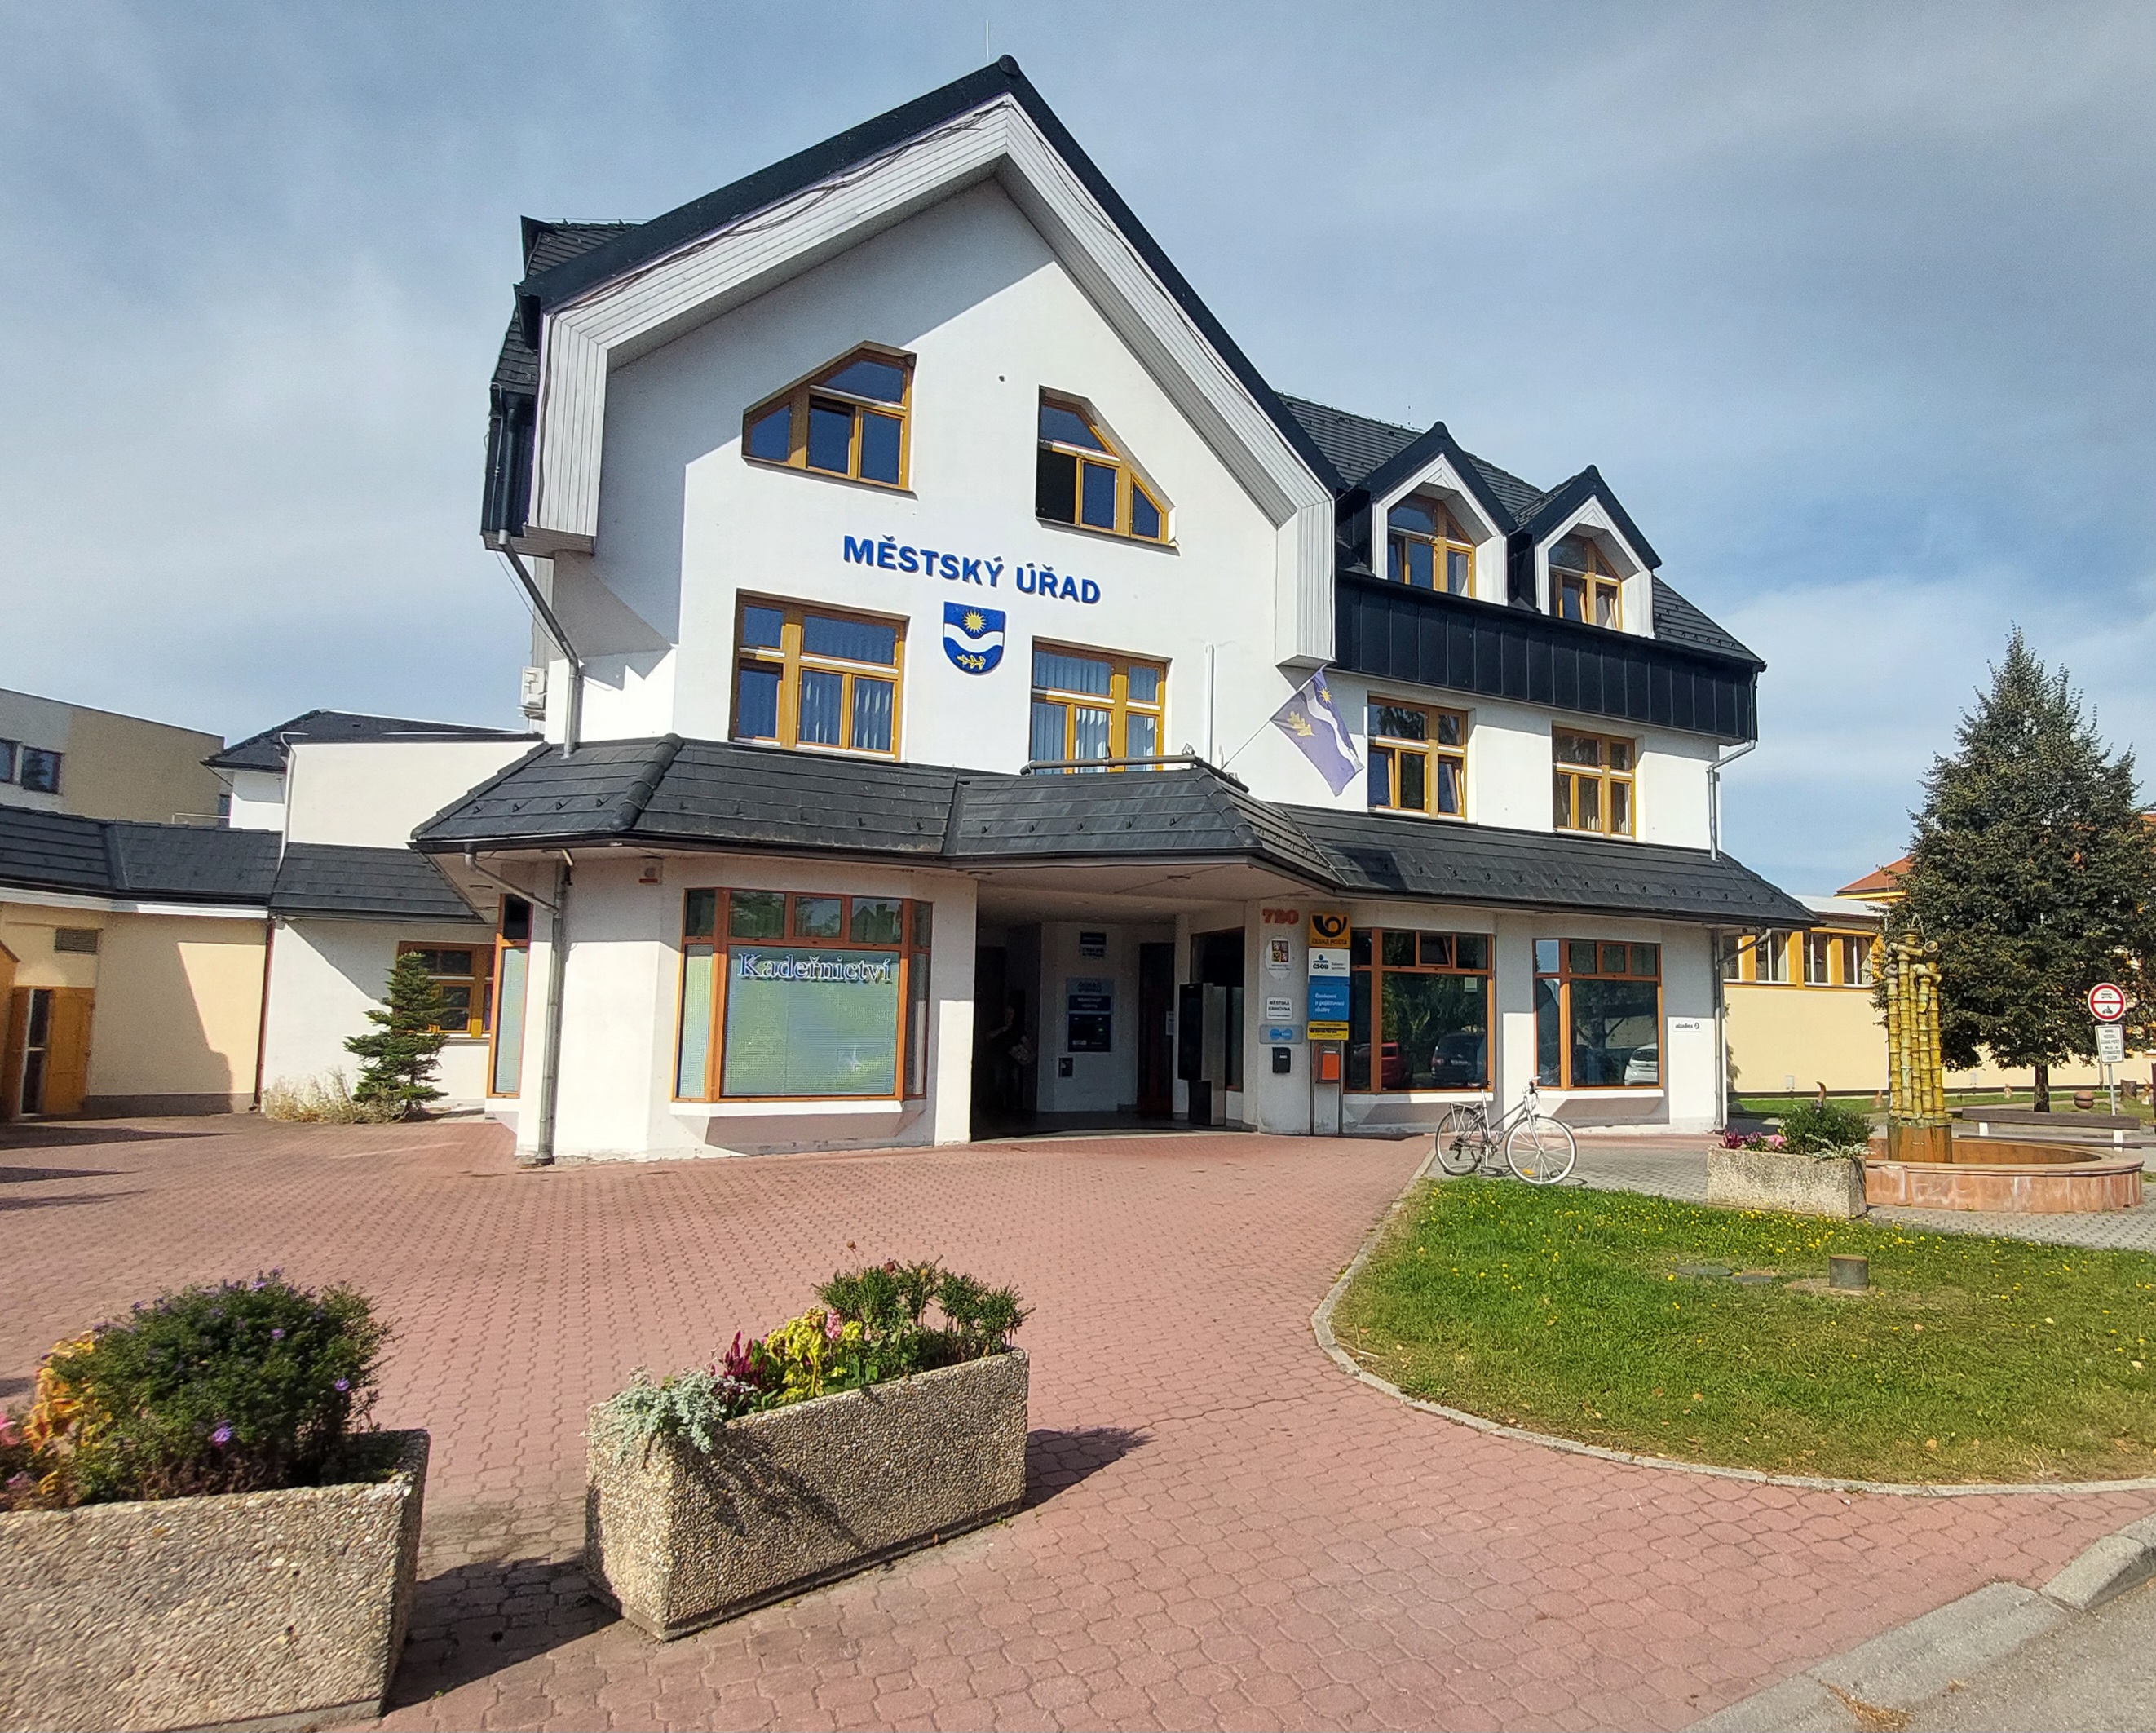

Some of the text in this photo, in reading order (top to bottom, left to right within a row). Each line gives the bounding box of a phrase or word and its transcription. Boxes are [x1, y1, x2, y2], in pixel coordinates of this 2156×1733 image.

[843, 534, 1101, 604] MĚSTSKÝ ÚŘAD
[737, 953, 890, 981] Kadeřnictví
